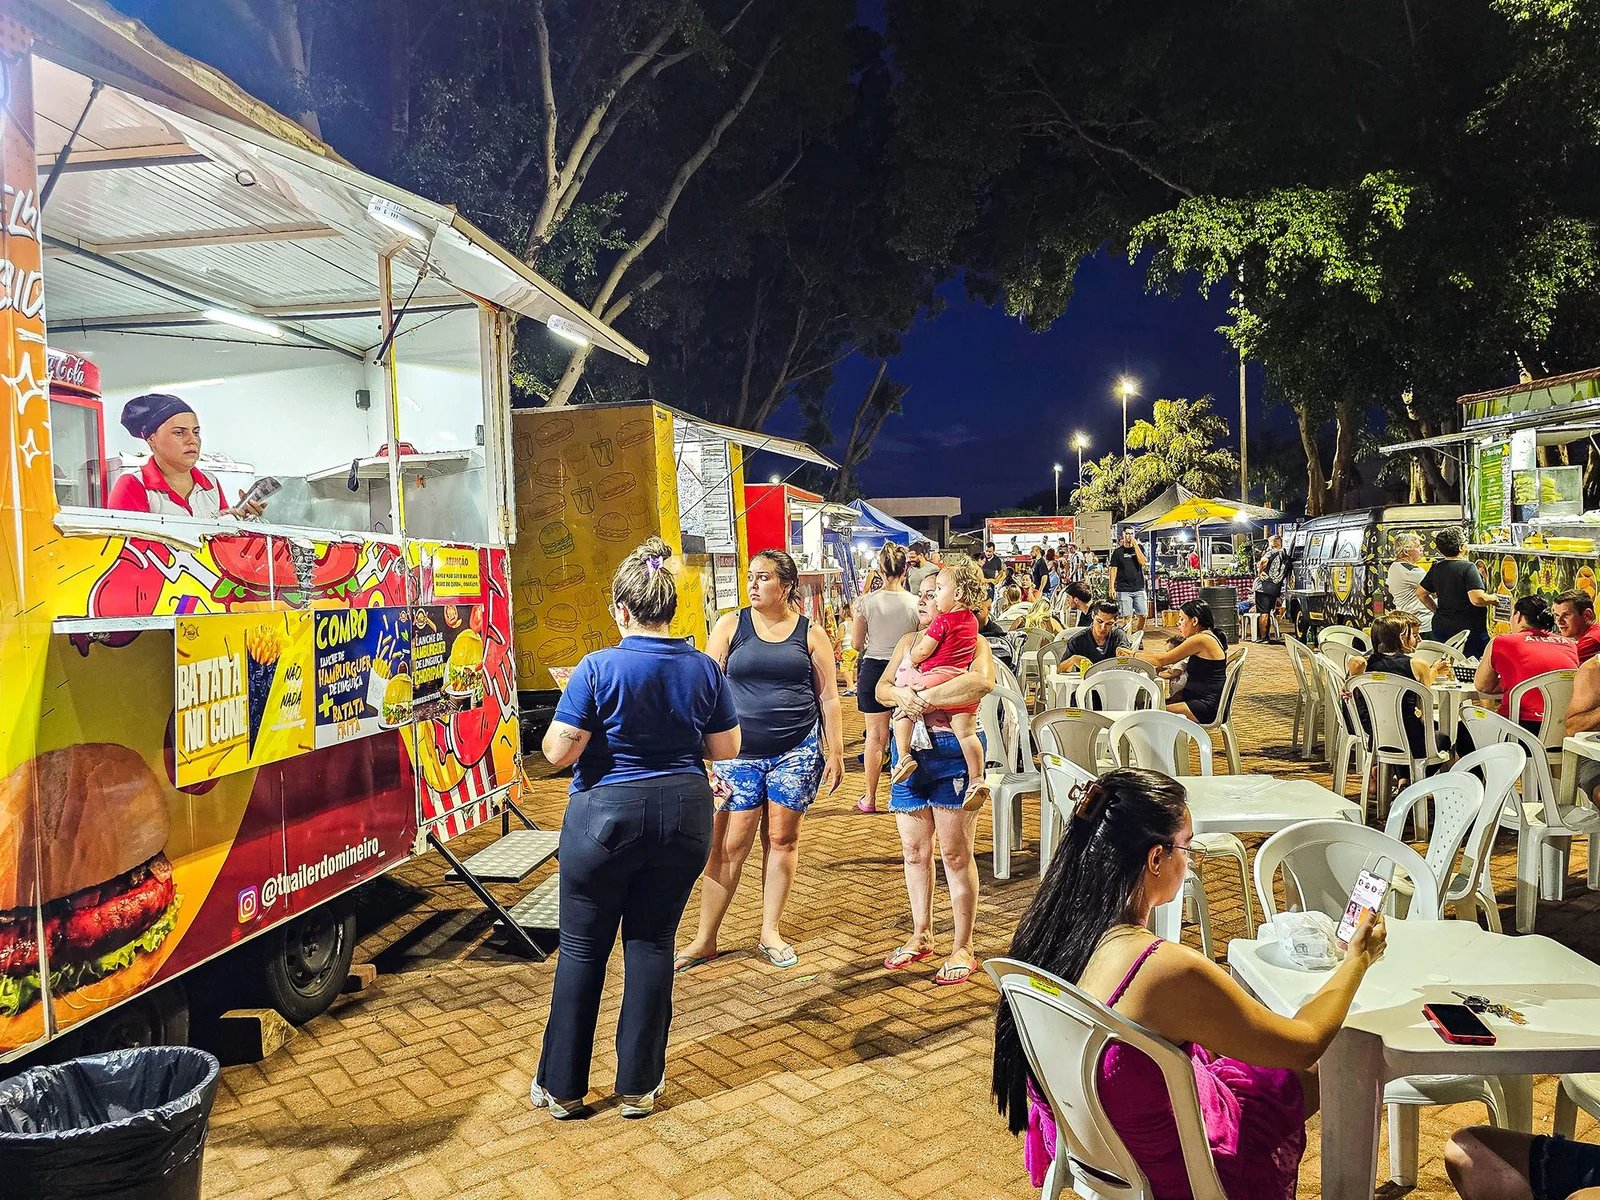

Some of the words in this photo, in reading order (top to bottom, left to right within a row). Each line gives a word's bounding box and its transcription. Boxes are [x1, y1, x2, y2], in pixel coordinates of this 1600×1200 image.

[445, 555, 469, 568] ATENÇÃO
[317, 608, 367, 650] COMBO
[415, 633, 436, 646] LANCHE
[436, 631, 443, 641] DE
[337, 651, 345, 662] DE
[416, 660, 423, 669] DE
[178, 653, 241, 710] BATATA
[284, 662, 302, 682] NÃO
[318, 655, 371, 687] HAMBURGUER
[329, 684, 338, 696] DE
[337, 675, 363, 695] LINGUIÇA
[280, 691, 302, 709] NADA
[333, 697, 365, 722] BATATA
[184, 707, 206, 754] NO
[210, 698, 248, 745] CONE
[337, 717, 361, 740] FRITA
[261, 837, 386, 907] @trailerdomineiro_
